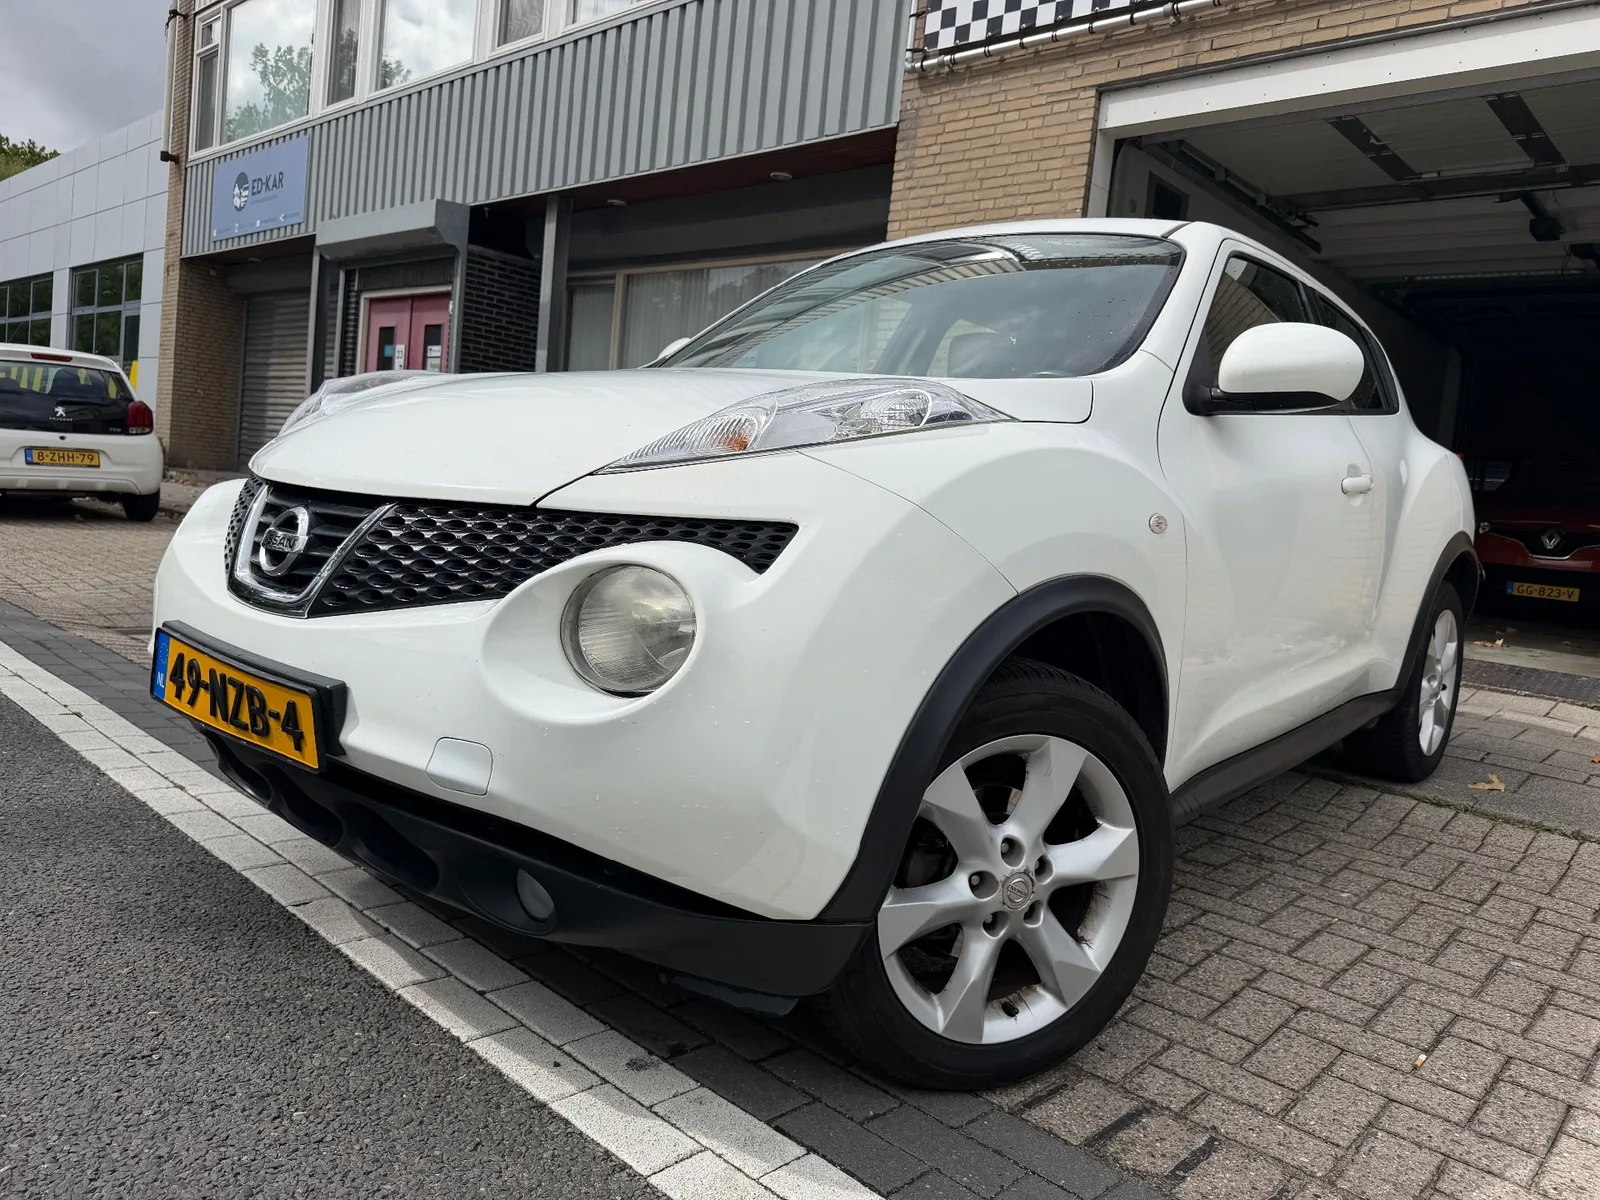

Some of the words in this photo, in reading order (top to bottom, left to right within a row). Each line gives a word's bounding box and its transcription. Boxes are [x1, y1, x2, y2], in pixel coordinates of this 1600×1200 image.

[251, 171, 284, 196] ED-KAR
[37, 451, 94, 464] 8-ZHH-79
[1516, 584, 1575, 599] GG-823-V
[156, 671, 165, 689] NL
[169, 651, 304, 752] 49-NZB-4
